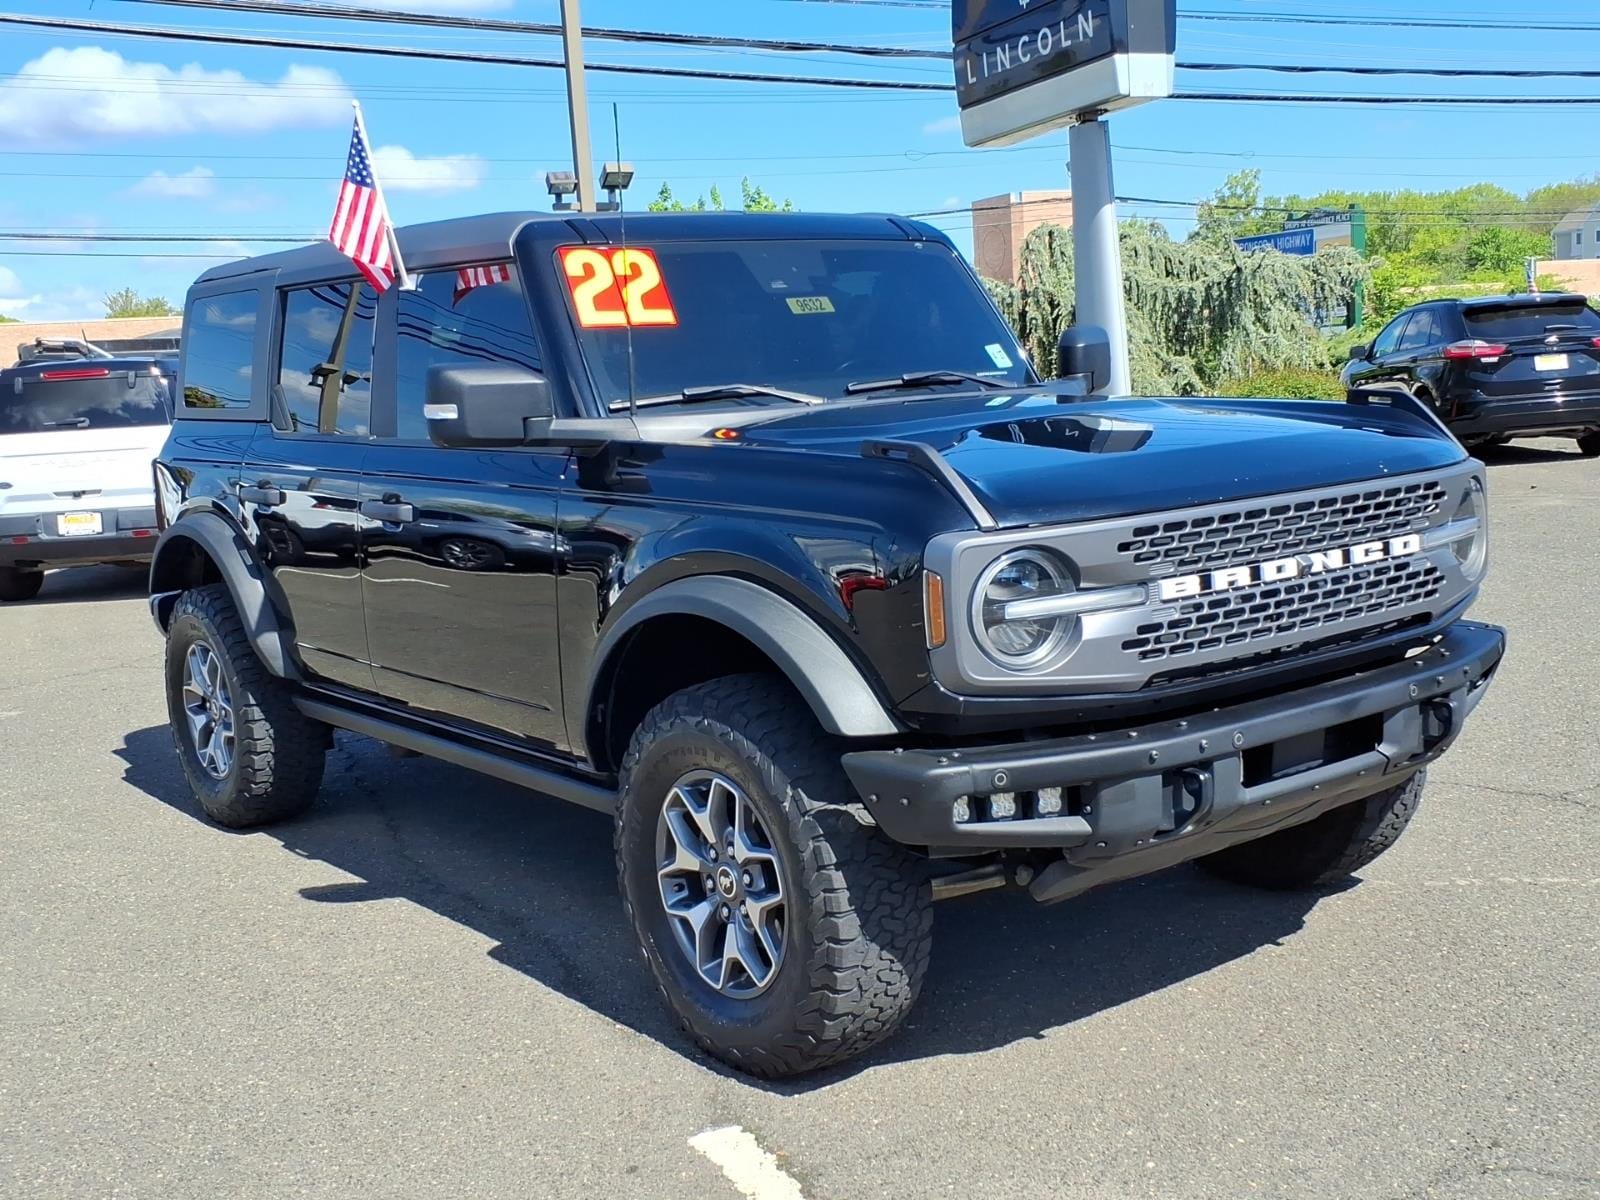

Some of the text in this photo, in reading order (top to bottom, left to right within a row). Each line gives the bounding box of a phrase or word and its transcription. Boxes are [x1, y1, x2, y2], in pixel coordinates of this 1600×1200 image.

[967, 10, 1094, 84] LINCOLN
[1277, 233, 1311, 249] HIGHWAY
[565, 249, 677, 325] 22
[796, 298, 826, 311] 9632
[1158, 533, 1420, 600] BRONCO
